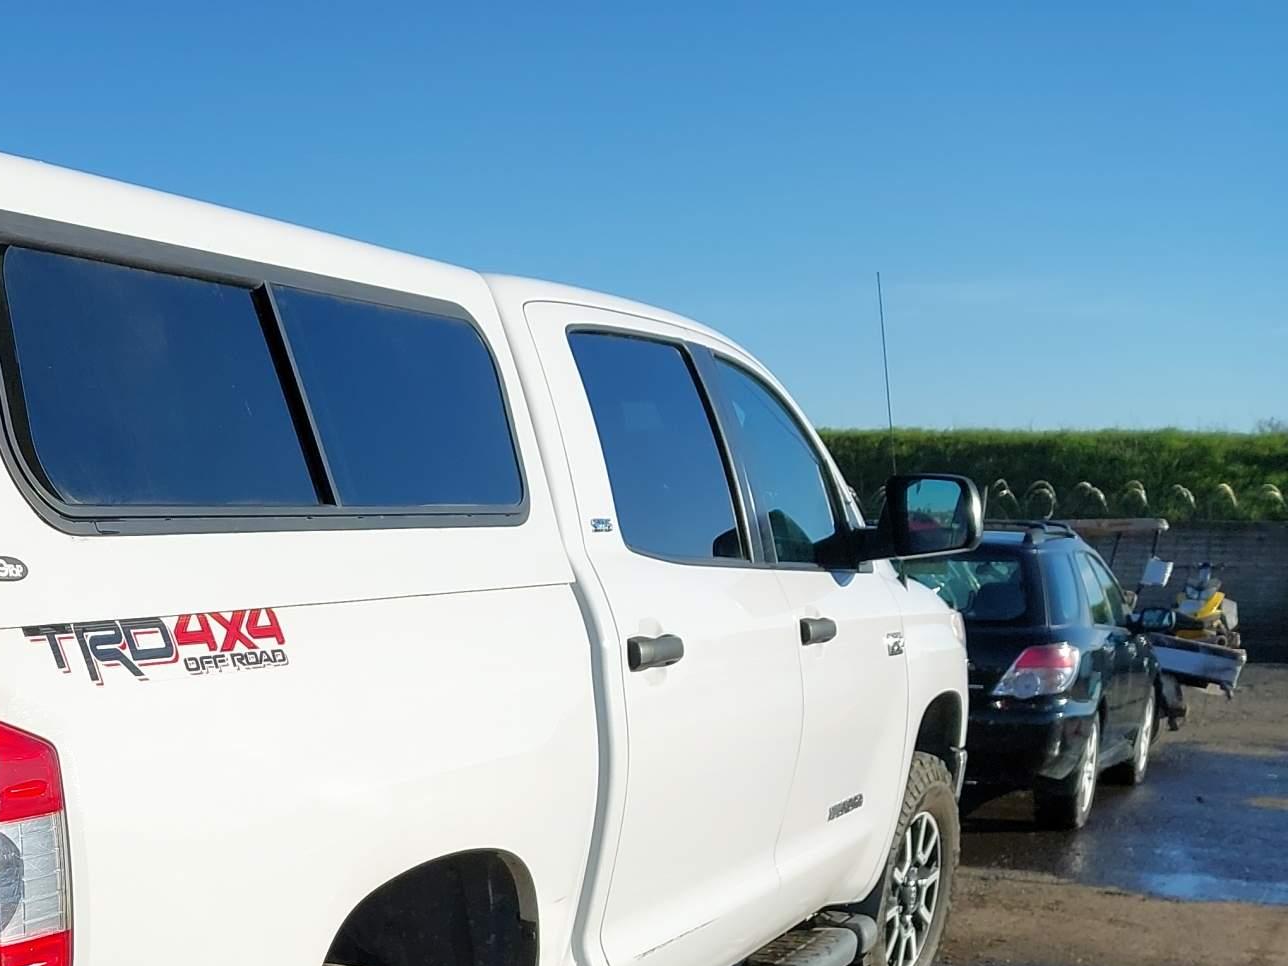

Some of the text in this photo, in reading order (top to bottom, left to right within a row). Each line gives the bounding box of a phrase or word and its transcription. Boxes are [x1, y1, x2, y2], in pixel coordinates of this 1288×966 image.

[21, 617, 179, 686] TRD
[183, 648, 289, 675] OFF ROAD
